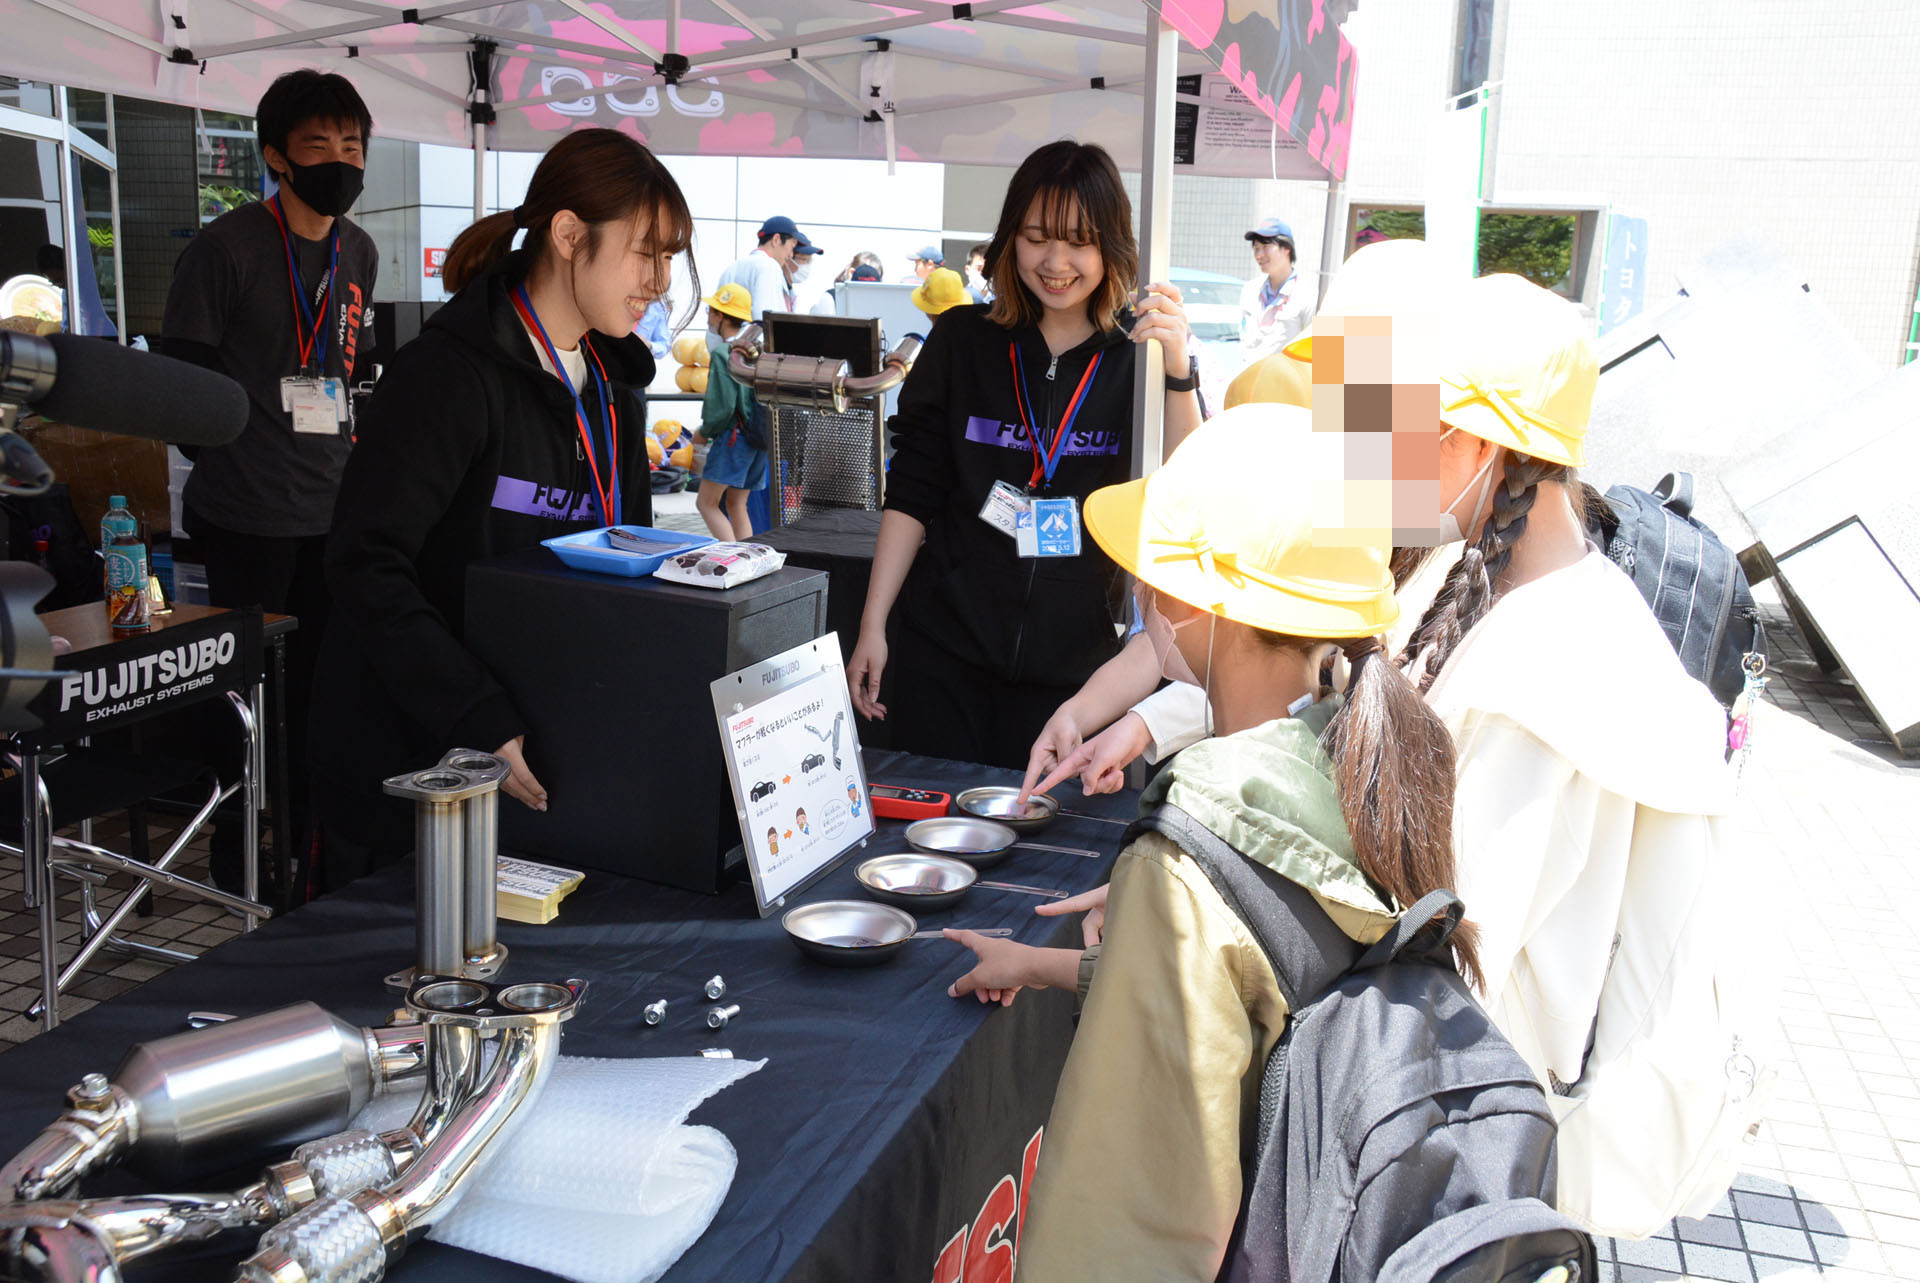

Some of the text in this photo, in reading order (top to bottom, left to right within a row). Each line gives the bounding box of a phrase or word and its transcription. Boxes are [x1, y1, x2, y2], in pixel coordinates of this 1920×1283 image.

[60, 632, 235, 712] FUJITSUBO
[762, 660, 800, 686] FUJITSUBO
[86, 674, 214, 722] EXHAUST SYSTEMS
